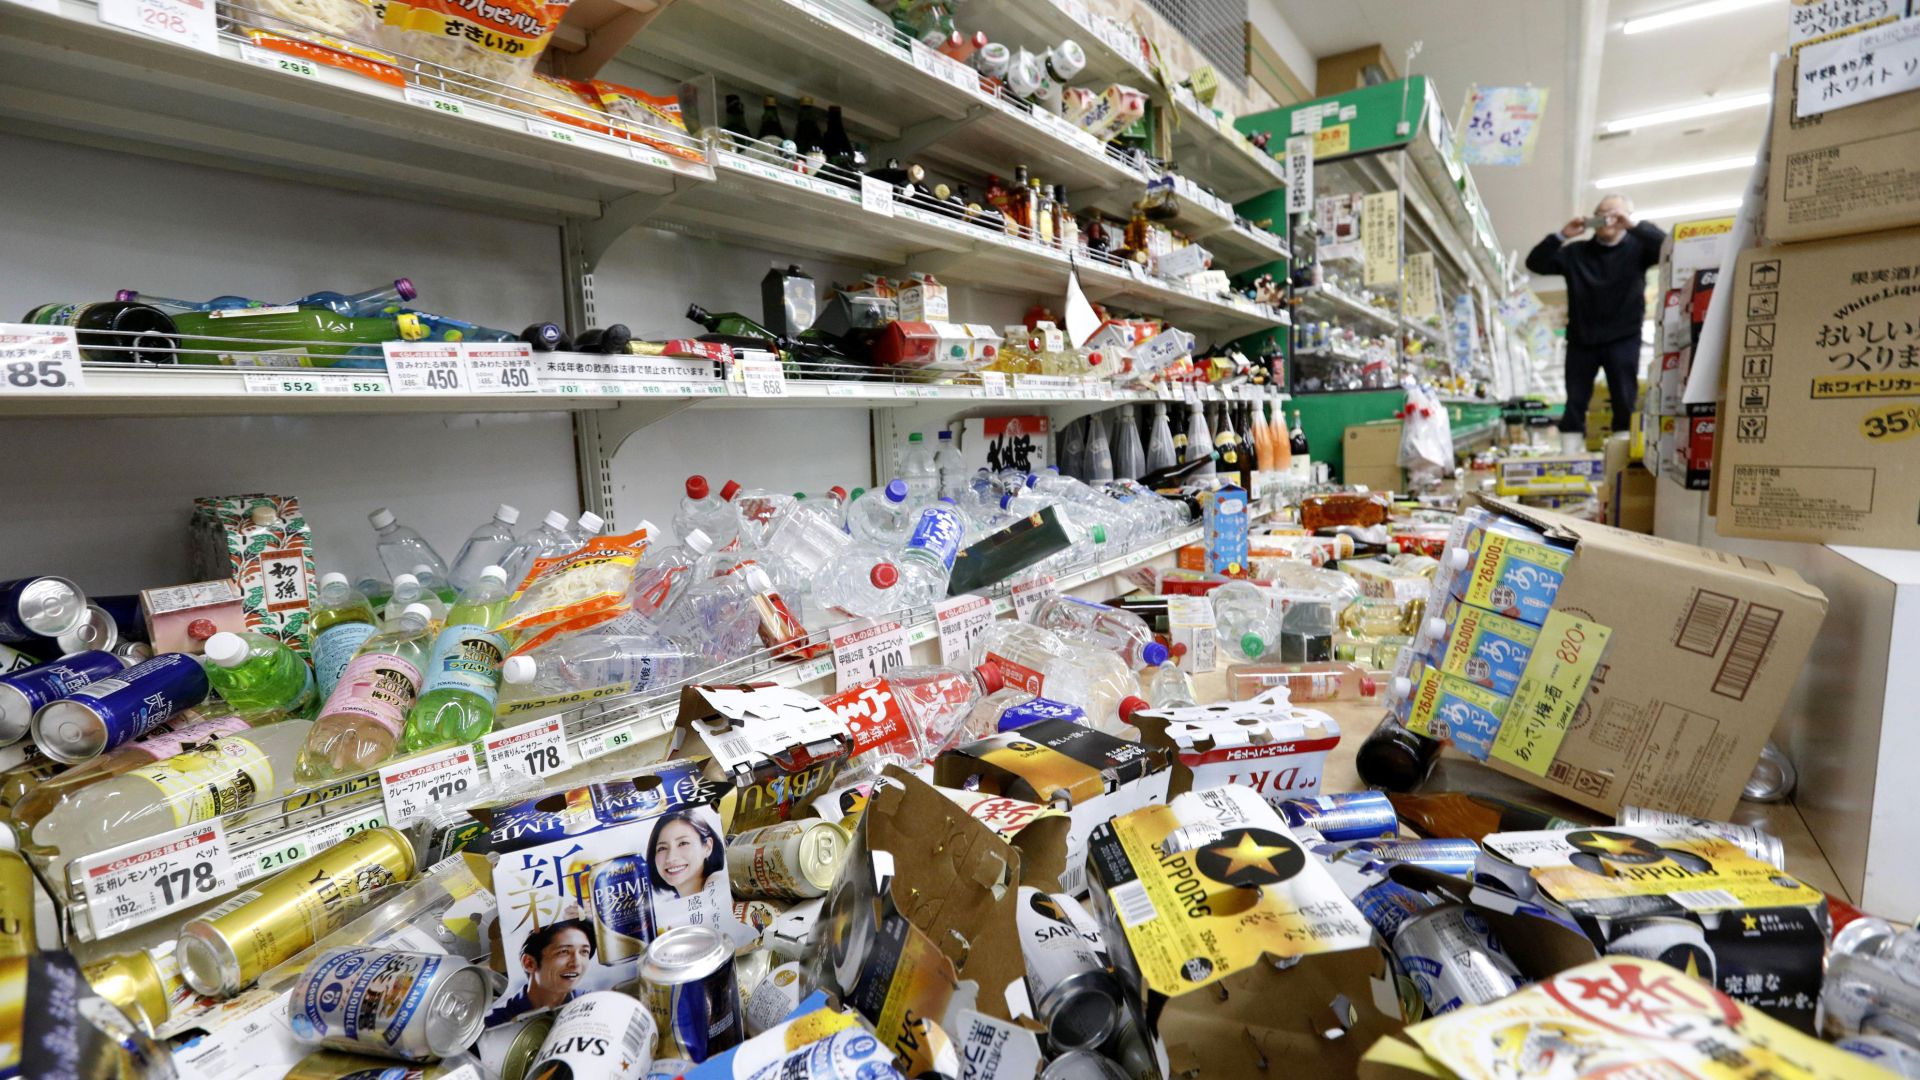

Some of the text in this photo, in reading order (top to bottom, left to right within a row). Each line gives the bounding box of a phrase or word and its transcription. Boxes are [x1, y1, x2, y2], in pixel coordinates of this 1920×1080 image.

[143, 8, 187, 34] 298
[445, 20, 524, 54] さきいか
[280, 60, 310, 75] 298
[434, 101, 459, 114] 298
[551, 130, 572, 142] 298
[1816, 320, 1920, 348] おいしい
[7, 361, 67, 388] 85
[395, 360, 458, 370] 澄みわたる梅酒
[546, 361, 710, 377] 未成年者の飲酒は法律で禁止されています。
[283, 382, 313, 392] 552
[353, 382, 381, 392] 552
[427, 368, 458, 390] 450
[501, 368, 529, 388] 450
[559, 385, 579, 393] 707
[763, 381, 781, 394] 658
[1818, 378, 1920, 393] ホワイトリカー
[1479, 545, 1502, 584] 26,000
[842, 623, 896, 644] くらしの応援価格
[1454, 617, 1477, 655] 26,000
[1556, 627, 1586, 665] 820
[838, 648, 864, 667] 甲類25度
[1419, 679, 1438, 716] 26,000
[1514, 683, 1563, 762] あっさり梅酒
[498, 726, 549, 746] くらしの応援価格
[547, 734, 561, 744] ペット
[613, 733, 628, 745] 95
[524, 745, 560, 775] 178
[1226, 743, 1296, 761] アサヒスーパードライ
[397, 757, 459, 780] くらしの応援価格
[1630, 741, 1661, 791] リキュール
[981, 799, 1041, 824] 新
[1200, 790, 1237, 828] 黒ラベル
[491, 809, 595, 845] PRIME
[107, 837, 200, 872] くらしの応援価格
[195, 845, 220, 860] ペット
[260, 846, 299, 870] 210
[154, 861, 226, 906] 178 円
[508, 844, 593, 932] 新
[595, 876, 648, 904] PRIME
[114, 902, 137, 918] 192
[115, 895, 130, 904] 1L
[688, 897, 703, 925] 感動
[316, 963, 330, 981] FOR
[417, 961, 435, 989] VALUE
[306, 981, 320, 1008] GOOD
[1563, 964, 1710, 1026] 新
[1724, 973, 1780, 995] 完璧な
[409, 989, 420, 1005] AND
[1733, 992, 1814, 1010] ビールを。
[345, 988, 359, 1032] DOUBLE
